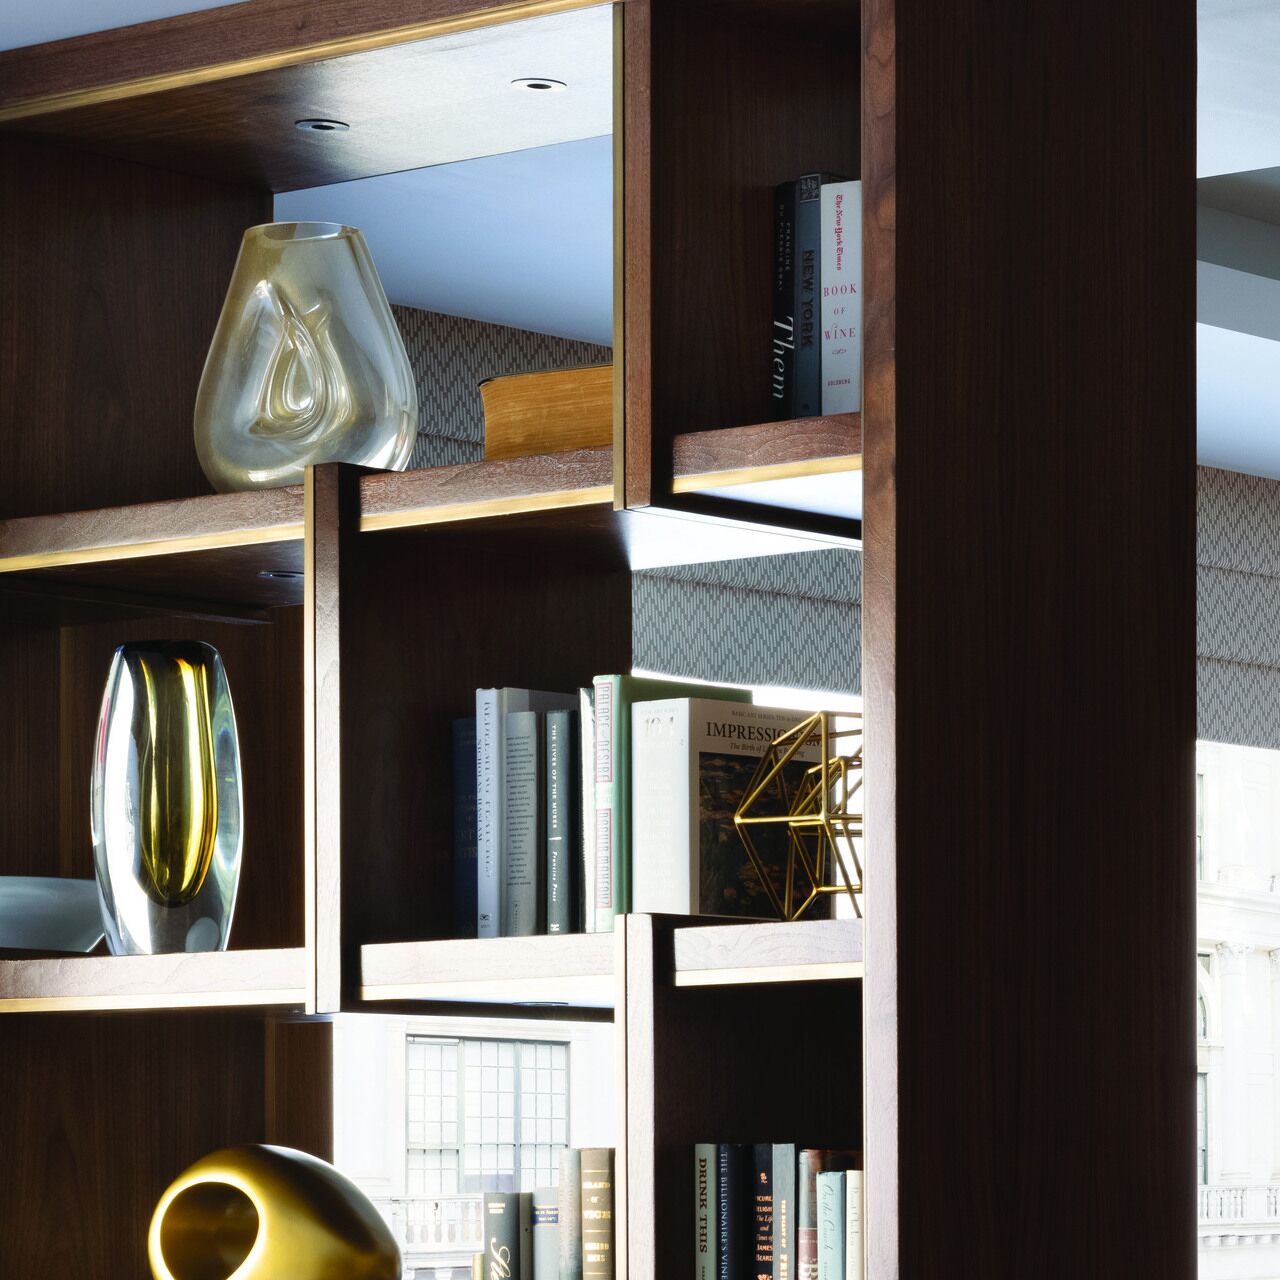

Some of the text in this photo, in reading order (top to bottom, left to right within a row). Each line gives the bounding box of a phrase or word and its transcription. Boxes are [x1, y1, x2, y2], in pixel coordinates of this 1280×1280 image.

[801, 250, 815, 349] NEW YORK
[823, 283, 857, 297] BOOK
[834, 307, 845, 316] OF
[772, 316, 794, 400] Them
[552, 769, 557, 781] OF
[720, 1152, 728, 1175] THE
[699, 1157, 707, 1254] DRINK THIS
